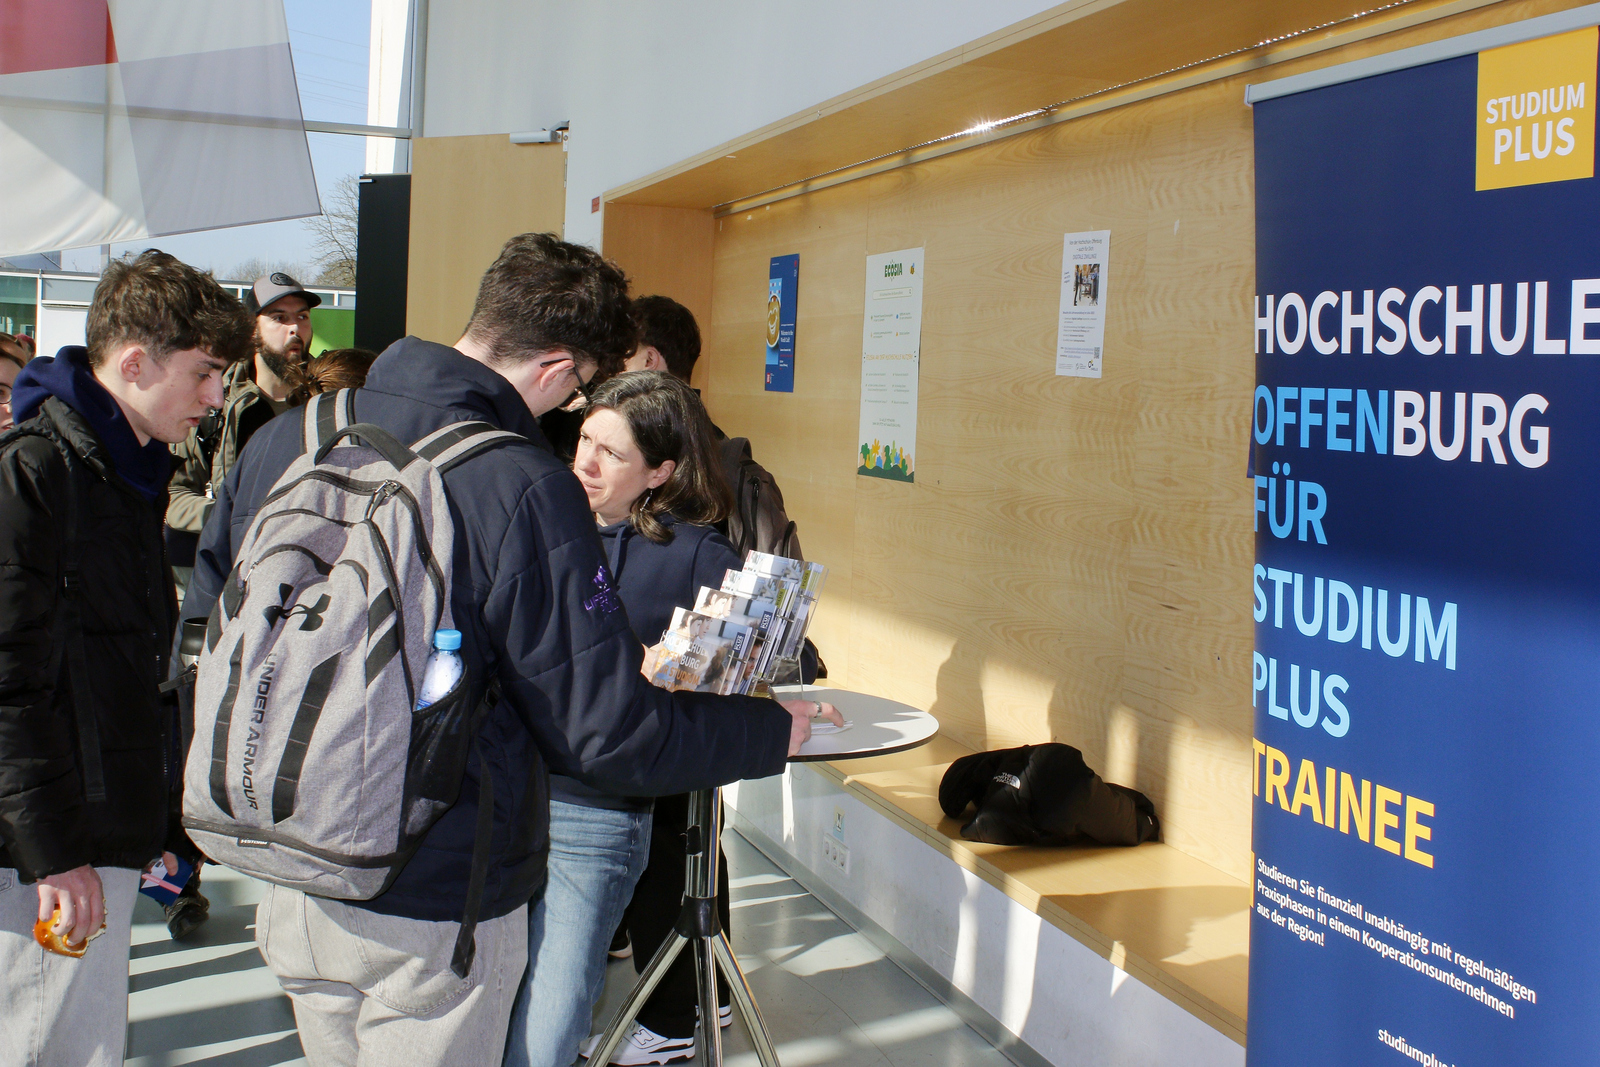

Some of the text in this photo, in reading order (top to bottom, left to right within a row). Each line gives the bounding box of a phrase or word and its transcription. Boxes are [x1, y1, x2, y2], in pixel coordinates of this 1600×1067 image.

[1485, 82, 1585, 124] STUDIUM
[1494, 117, 1576, 165] PLUS
[884, 263, 902, 277] ECOSIA
[1254, 278, 1600, 356] HOCHSCHULE
[1254, 384, 1550, 469] OFFENBURG
[1253, 461, 1328, 545] FÜR
[1253, 563, 1458, 671] STUDIUM
[250, 653, 277, 724] UNDER
[1252, 650, 1351, 738] PLUS
[242, 726, 261, 810] ARMOUR
[1252, 737, 1435, 869] TRAINEE
[1256, 902, 1325, 947] aus der Region!
[1257, 858, 1537, 1004] Studieren Sie finanziell unabhängig mit regelmäßigen
[1257, 878, 1515, 1019] Praxisphasen in einem Kooperationsunternehmen
[1378, 1029, 1456, 1067] studiumplu
